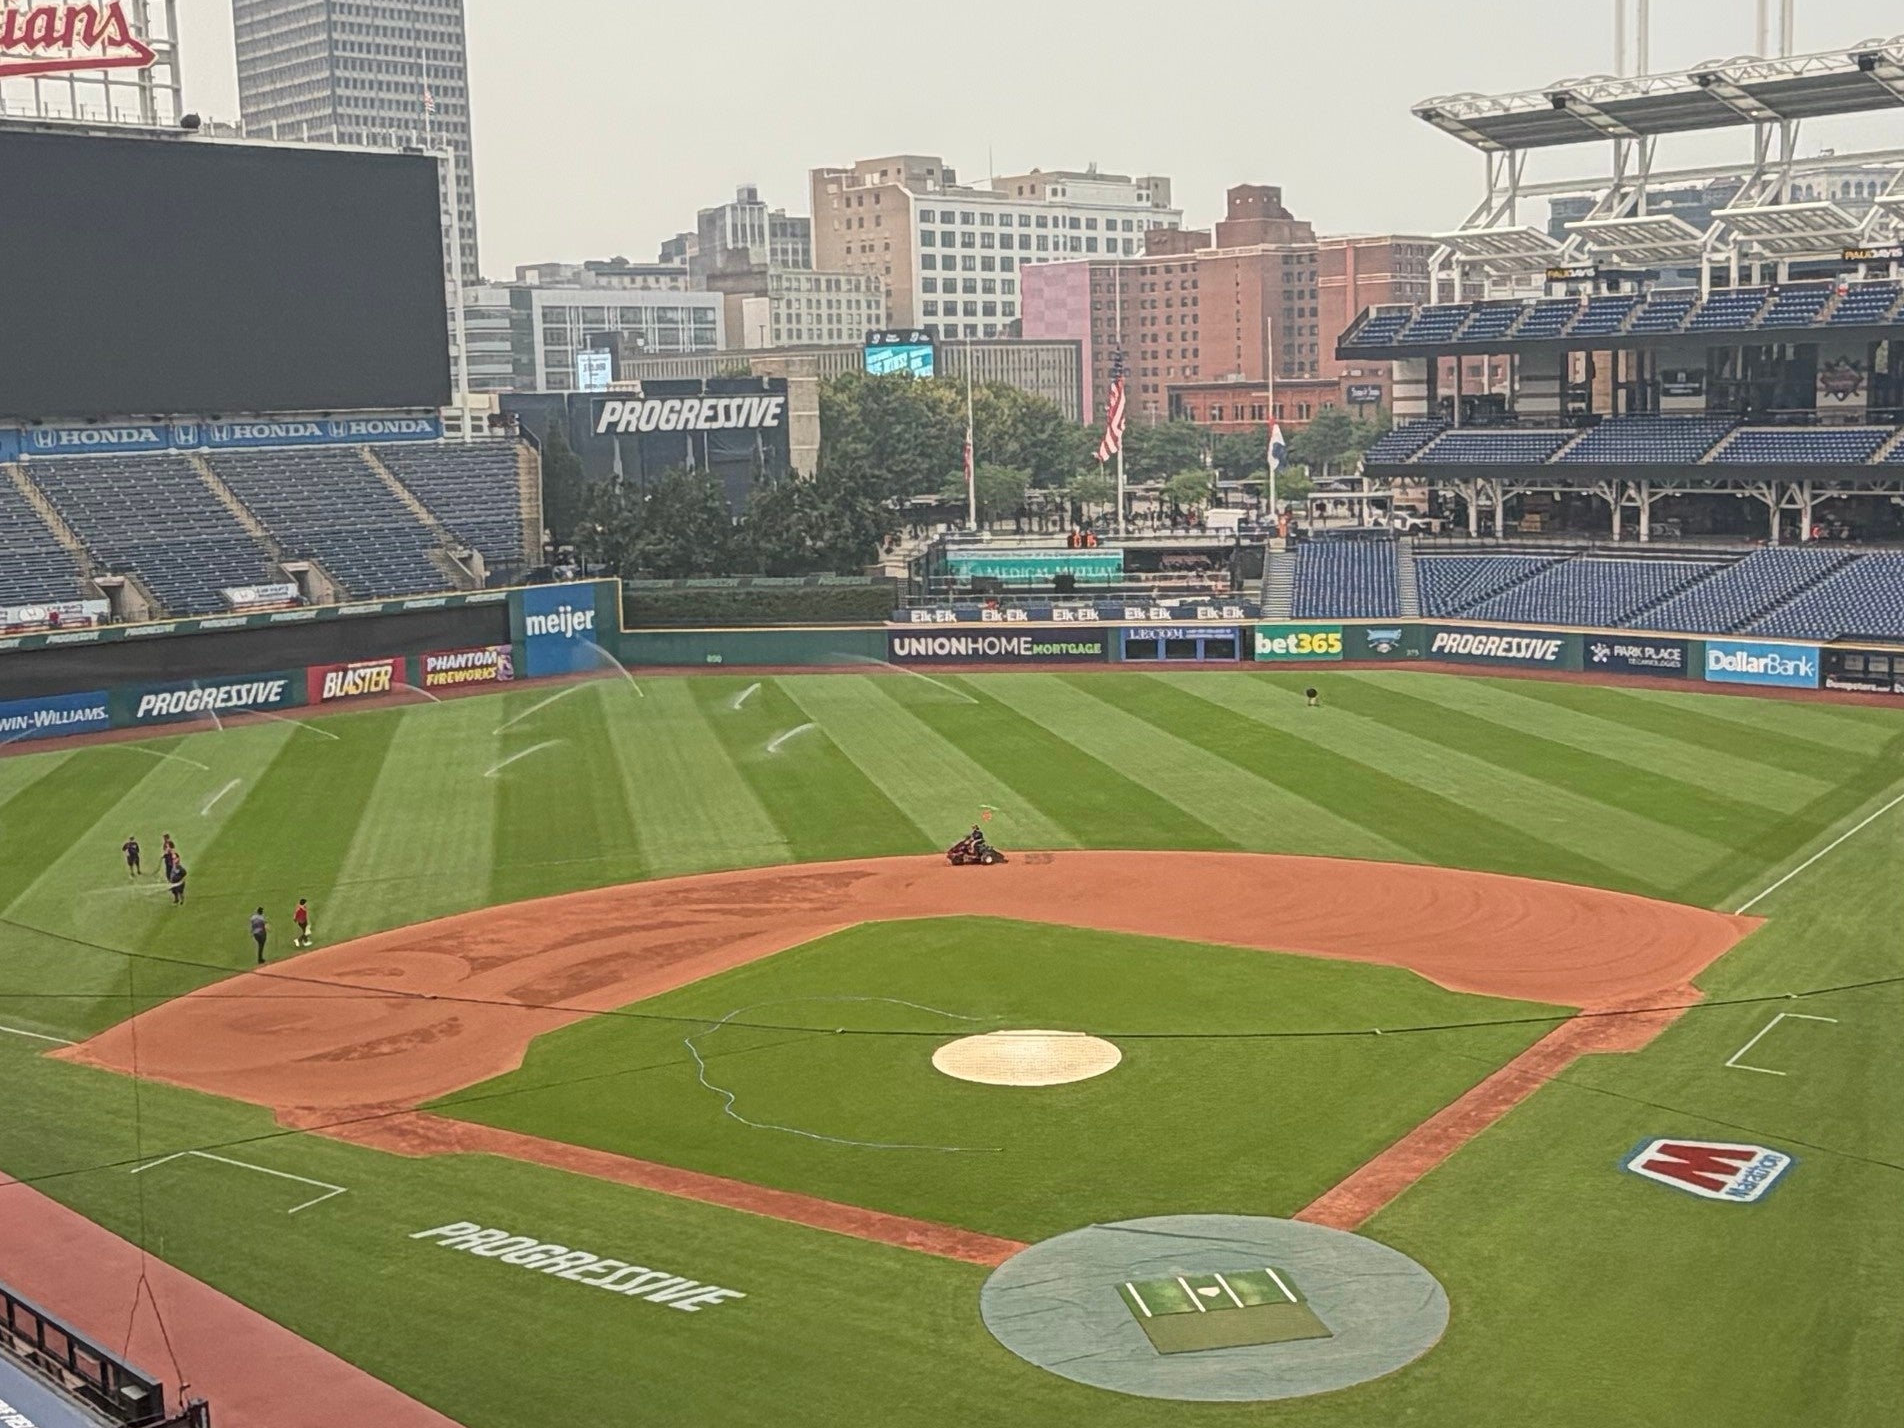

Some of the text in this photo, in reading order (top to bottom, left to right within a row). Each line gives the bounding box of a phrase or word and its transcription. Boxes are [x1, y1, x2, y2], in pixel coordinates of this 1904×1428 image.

[596, 395, 786, 434] PROGRESSIVE
[60, 429, 159, 445] HONDA
[234, 423, 322, 438] HONDA
[349, 419, 433, 435] HONDA
[525, 605, 596, 638] meijer
[1032, 642, 1102, 655] MORTGAGE
[1255, 632, 1342, 655] bet365
[1431, 632, 1564, 661] PROGRESSIVE
[1614, 645, 1682, 660] PARK PLACE
[426, 650, 497, 672] PHANTOM
[1708, 649, 1814, 677] DollarBank
[322, 665, 394, 699] BLASTER
[426, 666, 498, 687] FIREWORKS
[137, 679, 288, 718] PROGRESSIVE
[1724, 1153, 1785, 1199] Marathon
[409, 1221, 748, 1312] PROGRESSIVE
